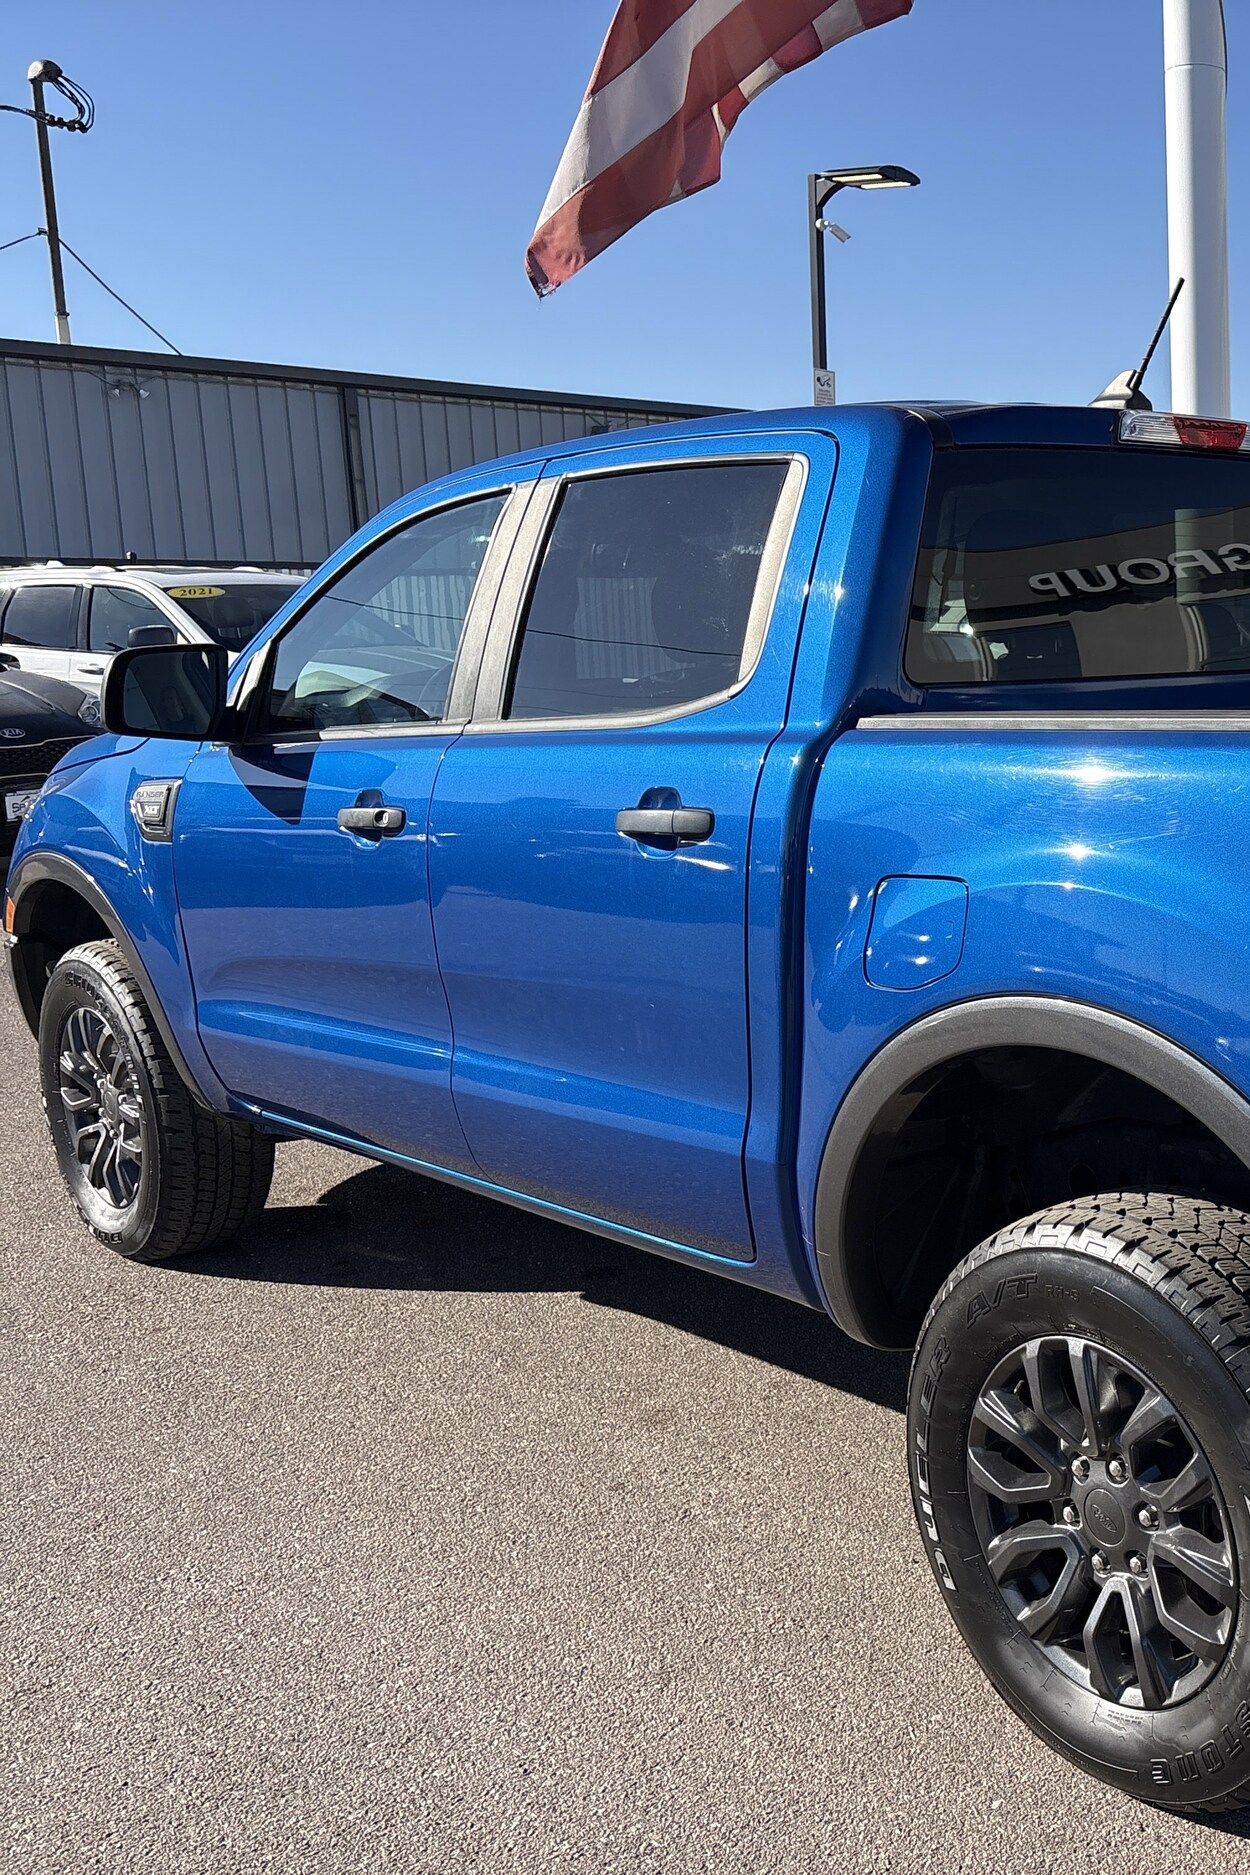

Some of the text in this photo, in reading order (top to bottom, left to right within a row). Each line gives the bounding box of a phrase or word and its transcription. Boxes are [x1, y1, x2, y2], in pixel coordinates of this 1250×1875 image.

[179, 588, 213, 597] 2021
[2, 728, 23, 738] KIA
[144, 804, 161, 815] XLT
[966, 1272, 1038, 1330] A/T
